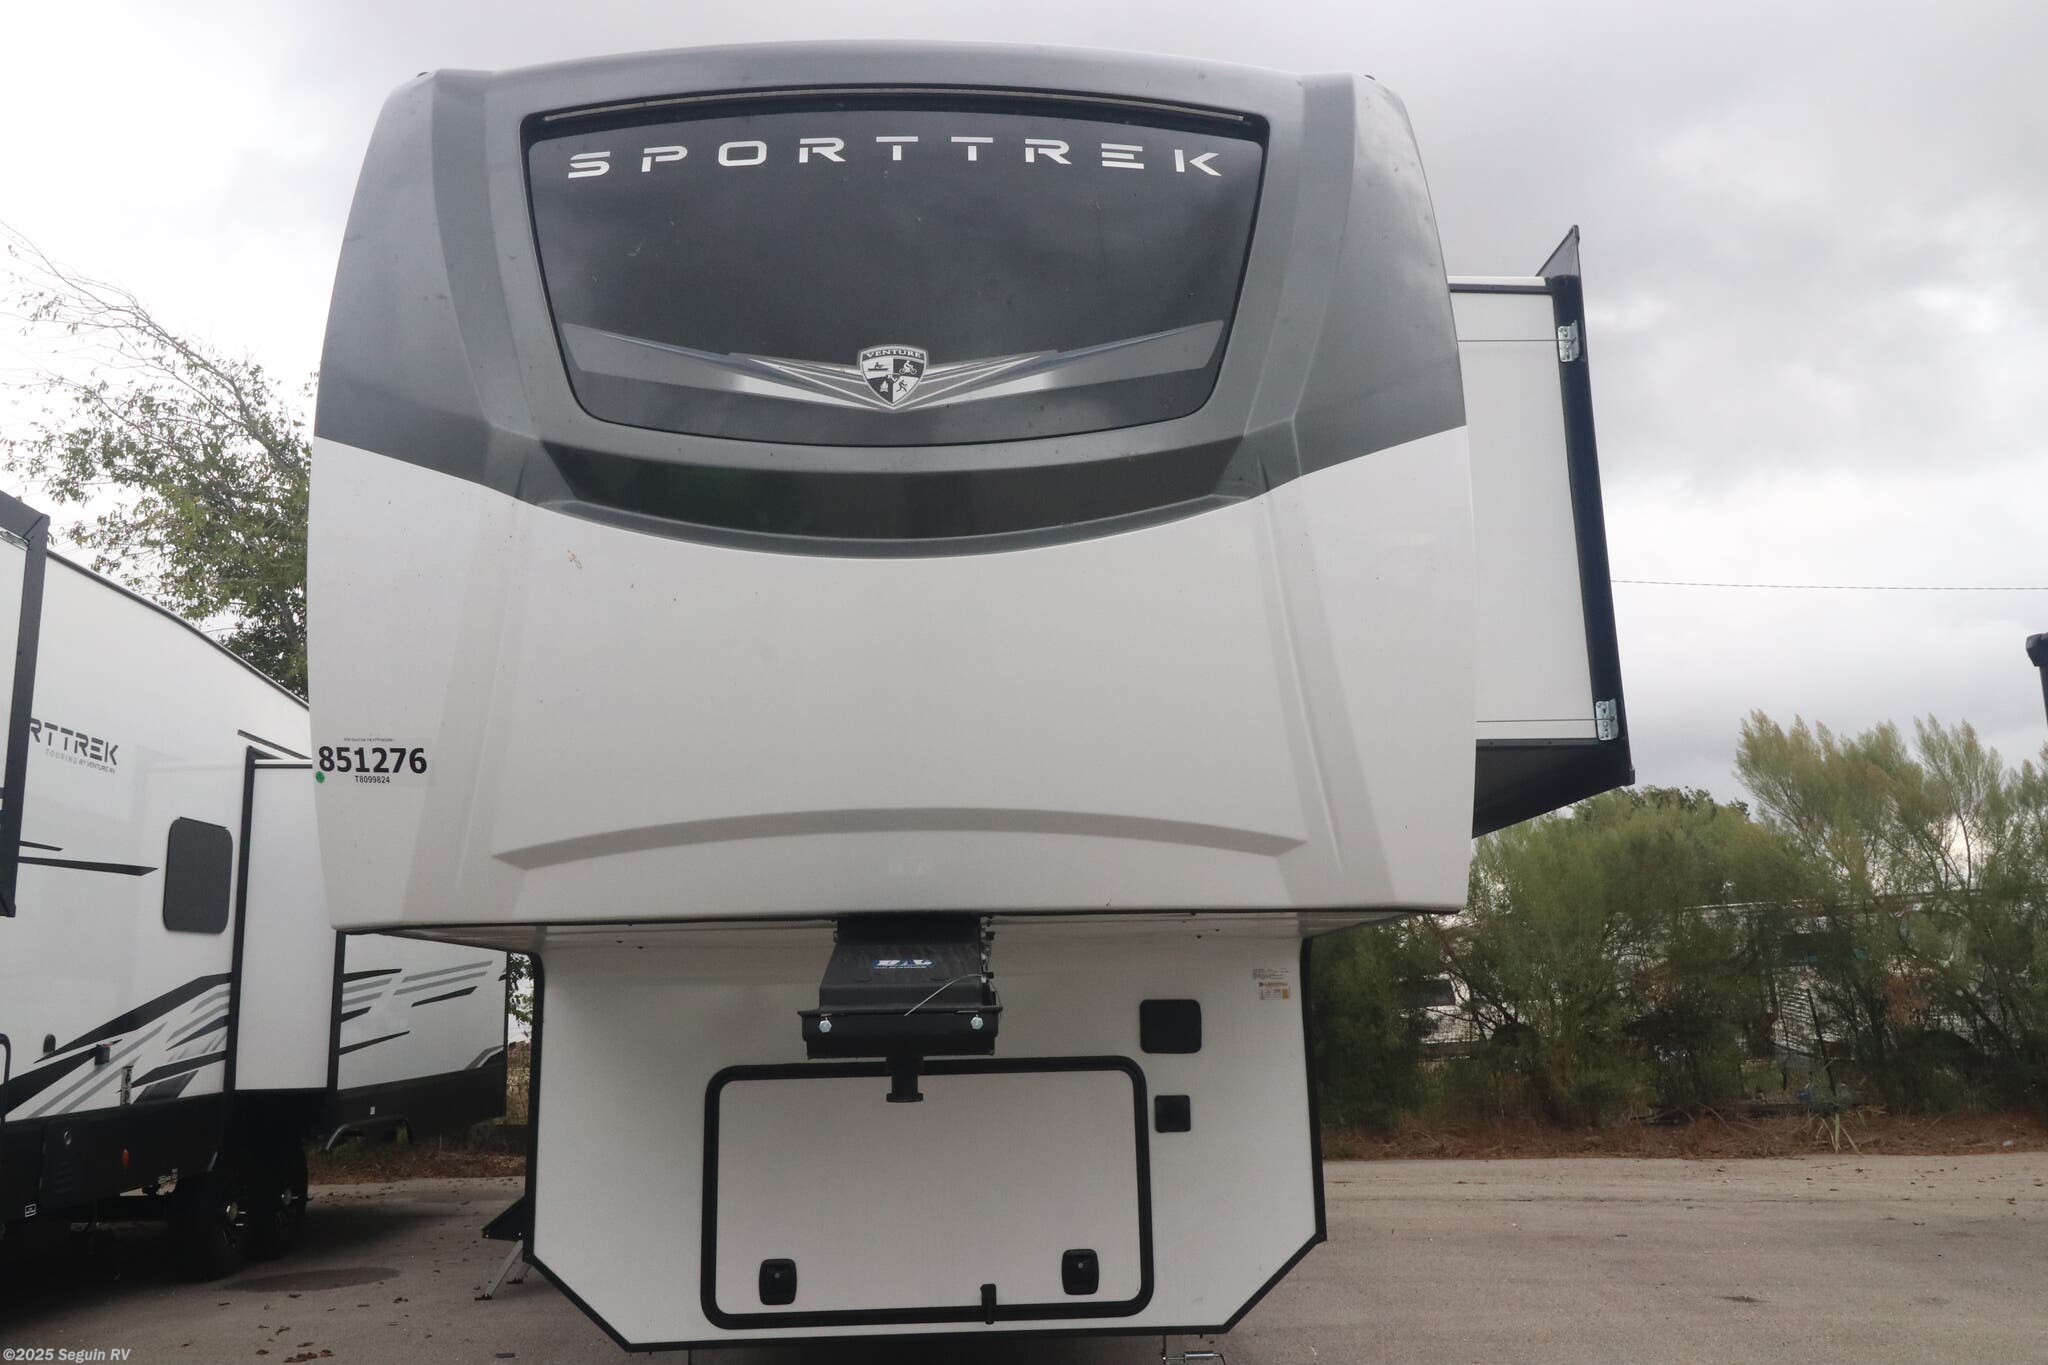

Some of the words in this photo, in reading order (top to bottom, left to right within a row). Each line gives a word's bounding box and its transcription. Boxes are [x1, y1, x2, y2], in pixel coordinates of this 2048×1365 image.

[568, 136, 1222, 178] SPORTTREK
[866, 349, 922, 358] VENTURE
[318, 746, 428, 774] 851276
